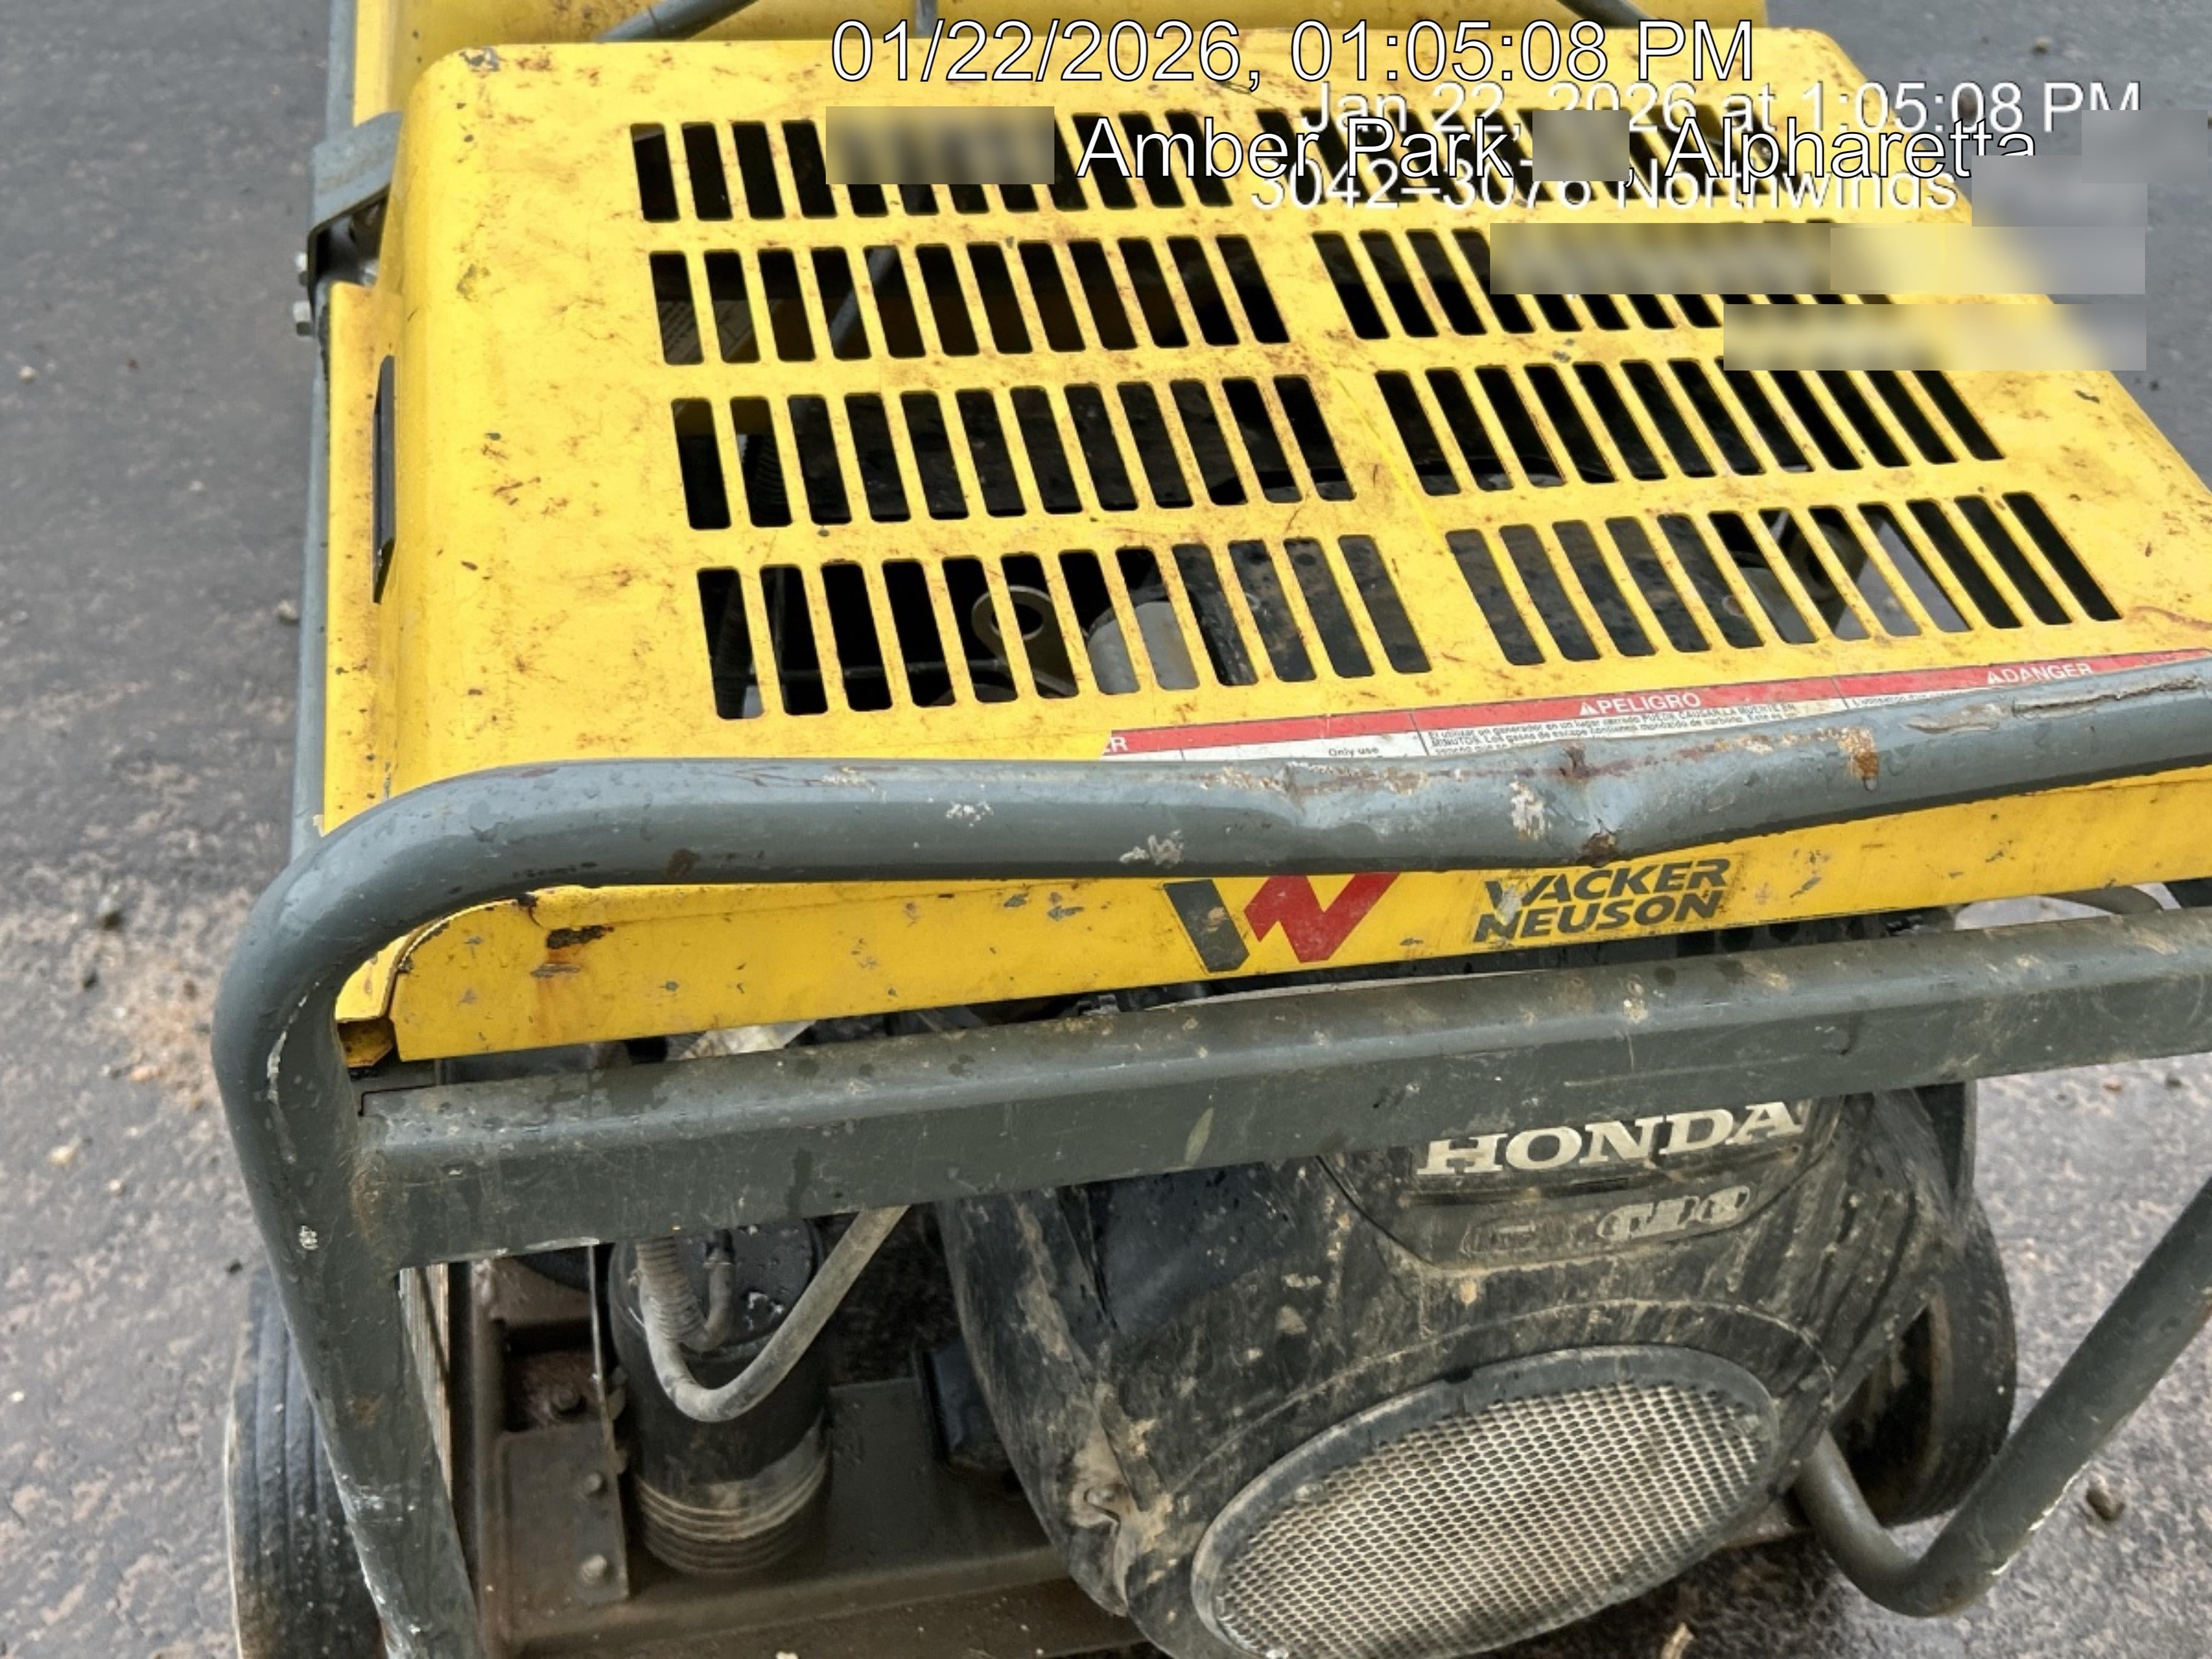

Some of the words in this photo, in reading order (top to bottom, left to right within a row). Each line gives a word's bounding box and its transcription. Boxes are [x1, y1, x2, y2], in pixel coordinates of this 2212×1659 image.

[2001, 663, 2093, 683] DANGER
[1596, 692, 1701, 715] PELIGRO
[1328, 747, 1354, 758] Only
[1474, 890, 1724, 943] NEUSON
[1417, 1101, 1805, 1175] HONDA
